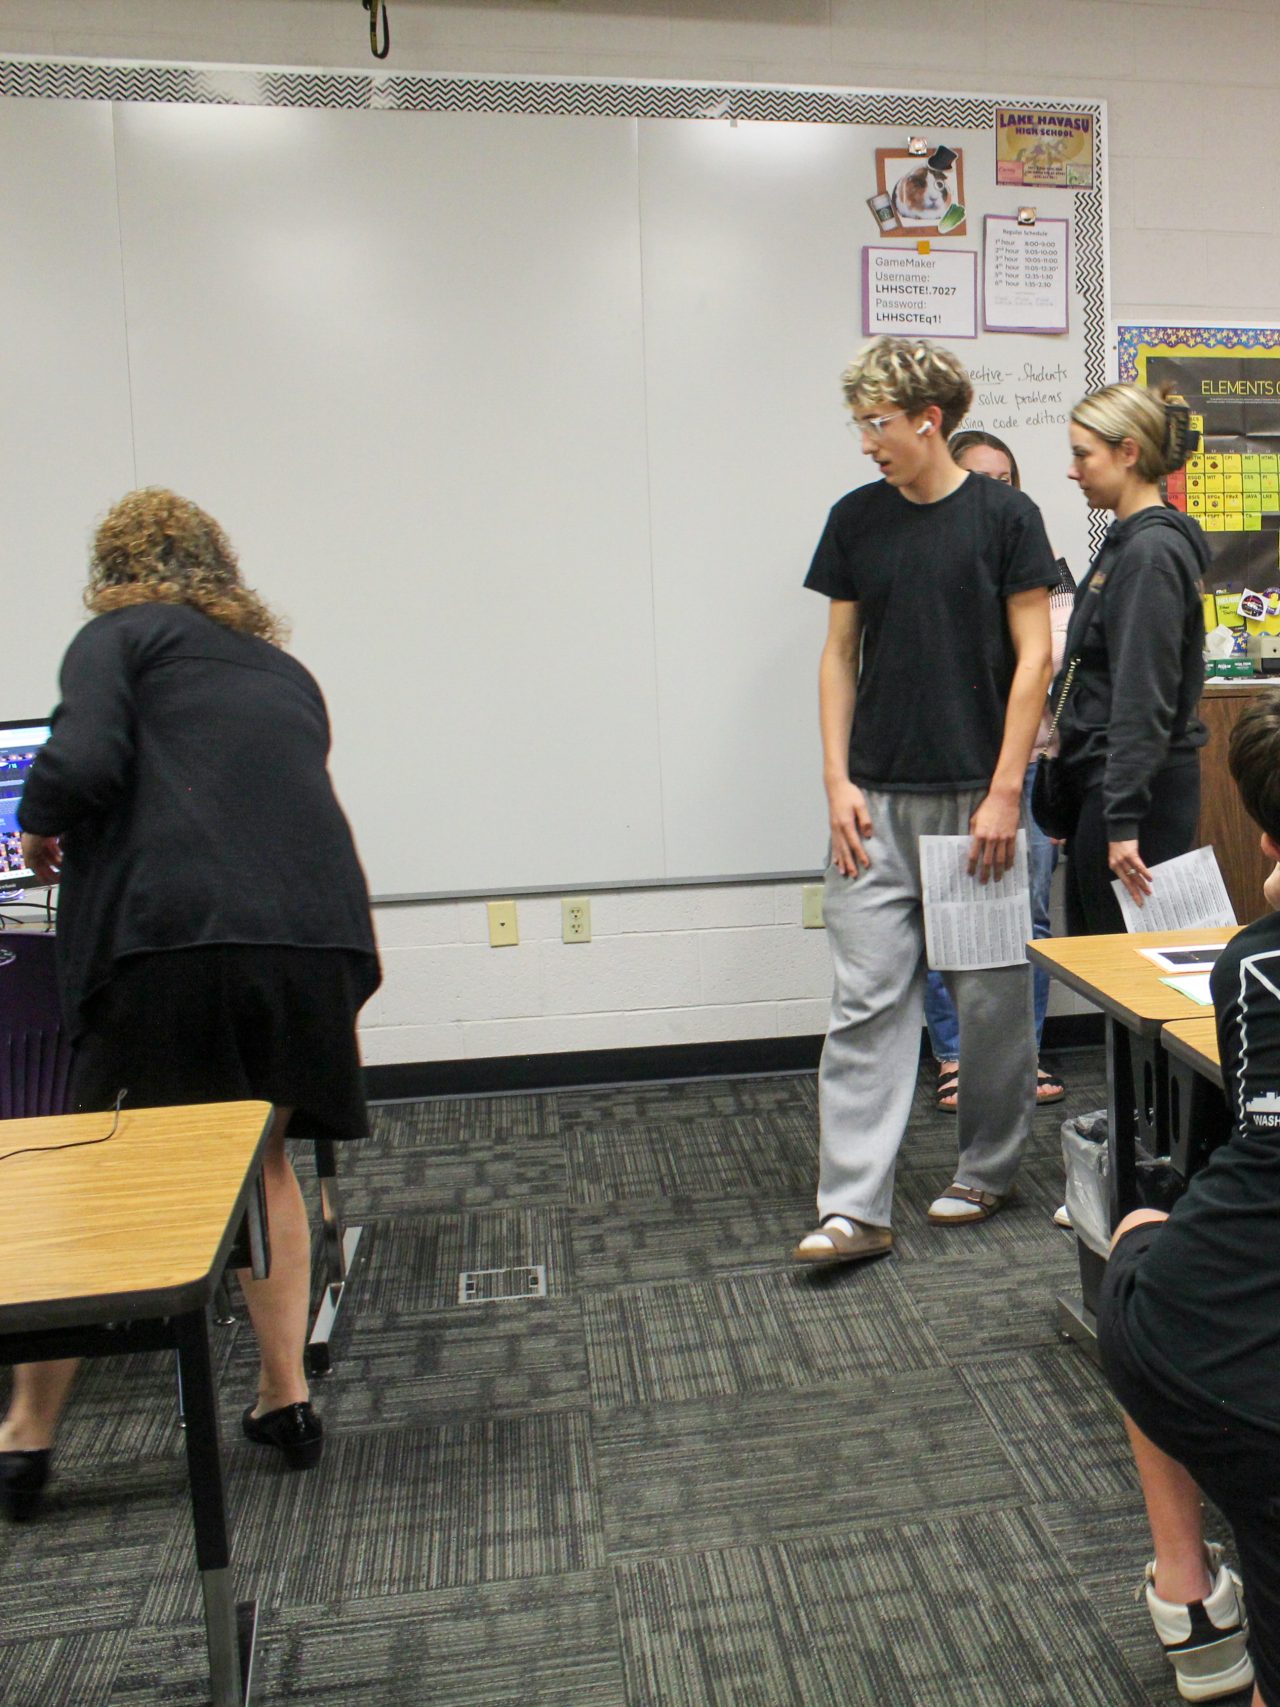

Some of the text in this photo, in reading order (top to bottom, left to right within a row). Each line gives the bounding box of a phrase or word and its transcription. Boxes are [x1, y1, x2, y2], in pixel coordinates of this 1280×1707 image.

[1000, 113, 1090, 133] LAKE HAVASU
[1015, 127, 1074, 138] HIGH SCHOOL
[875, 256, 936, 269] GameMaker
[875, 271, 930, 283] Username:
[875, 284, 957, 296] LHHSCTE!.7027
[875, 298, 927, 309] Password:
[1017, 363, 1068, 382] Students
[1201, 380, 1273, 395] ELEMENTS
[978, 391, 1063, 411] solve problems
[992, 415, 1019, 429] code
